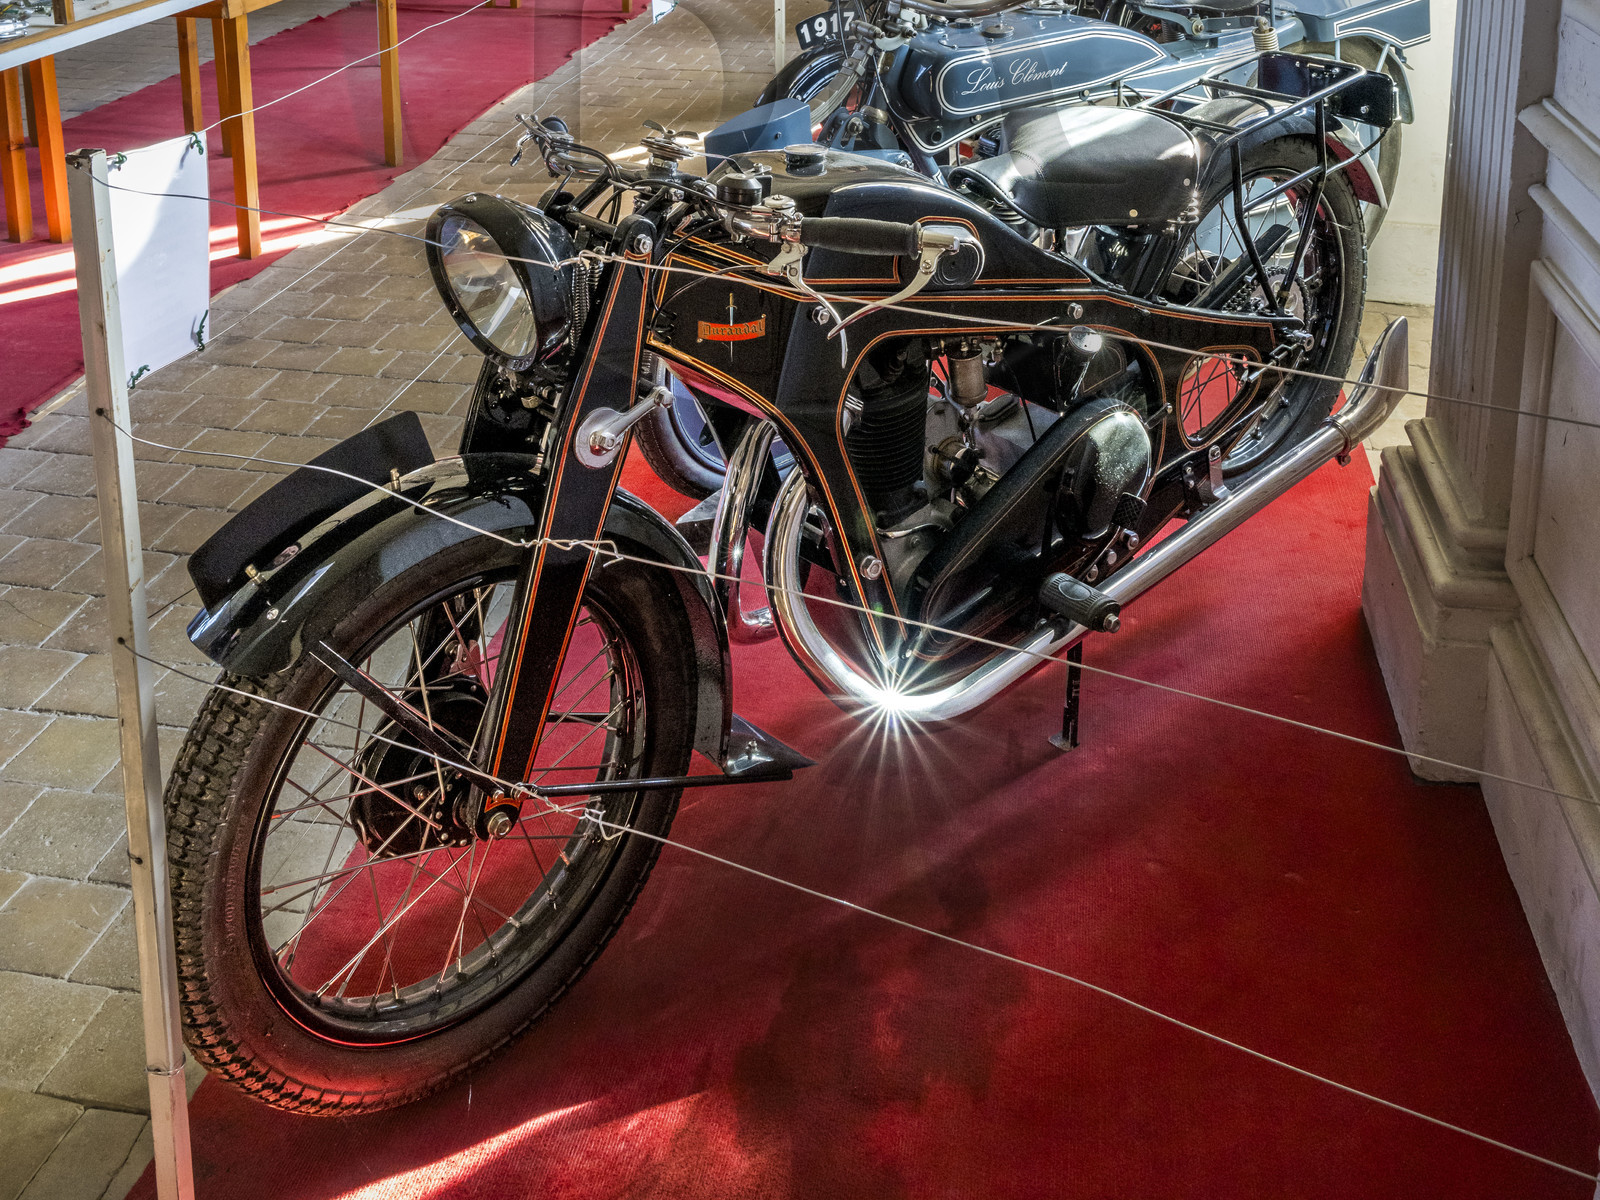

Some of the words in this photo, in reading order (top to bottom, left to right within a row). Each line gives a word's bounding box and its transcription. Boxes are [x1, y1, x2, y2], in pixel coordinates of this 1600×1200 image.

[800, 11, 855, 44] 1917
[961, 66, 1006, 96] Louis
[1009, 58, 1068, 86] Clément
[703, 321, 764, 336] Durandal
